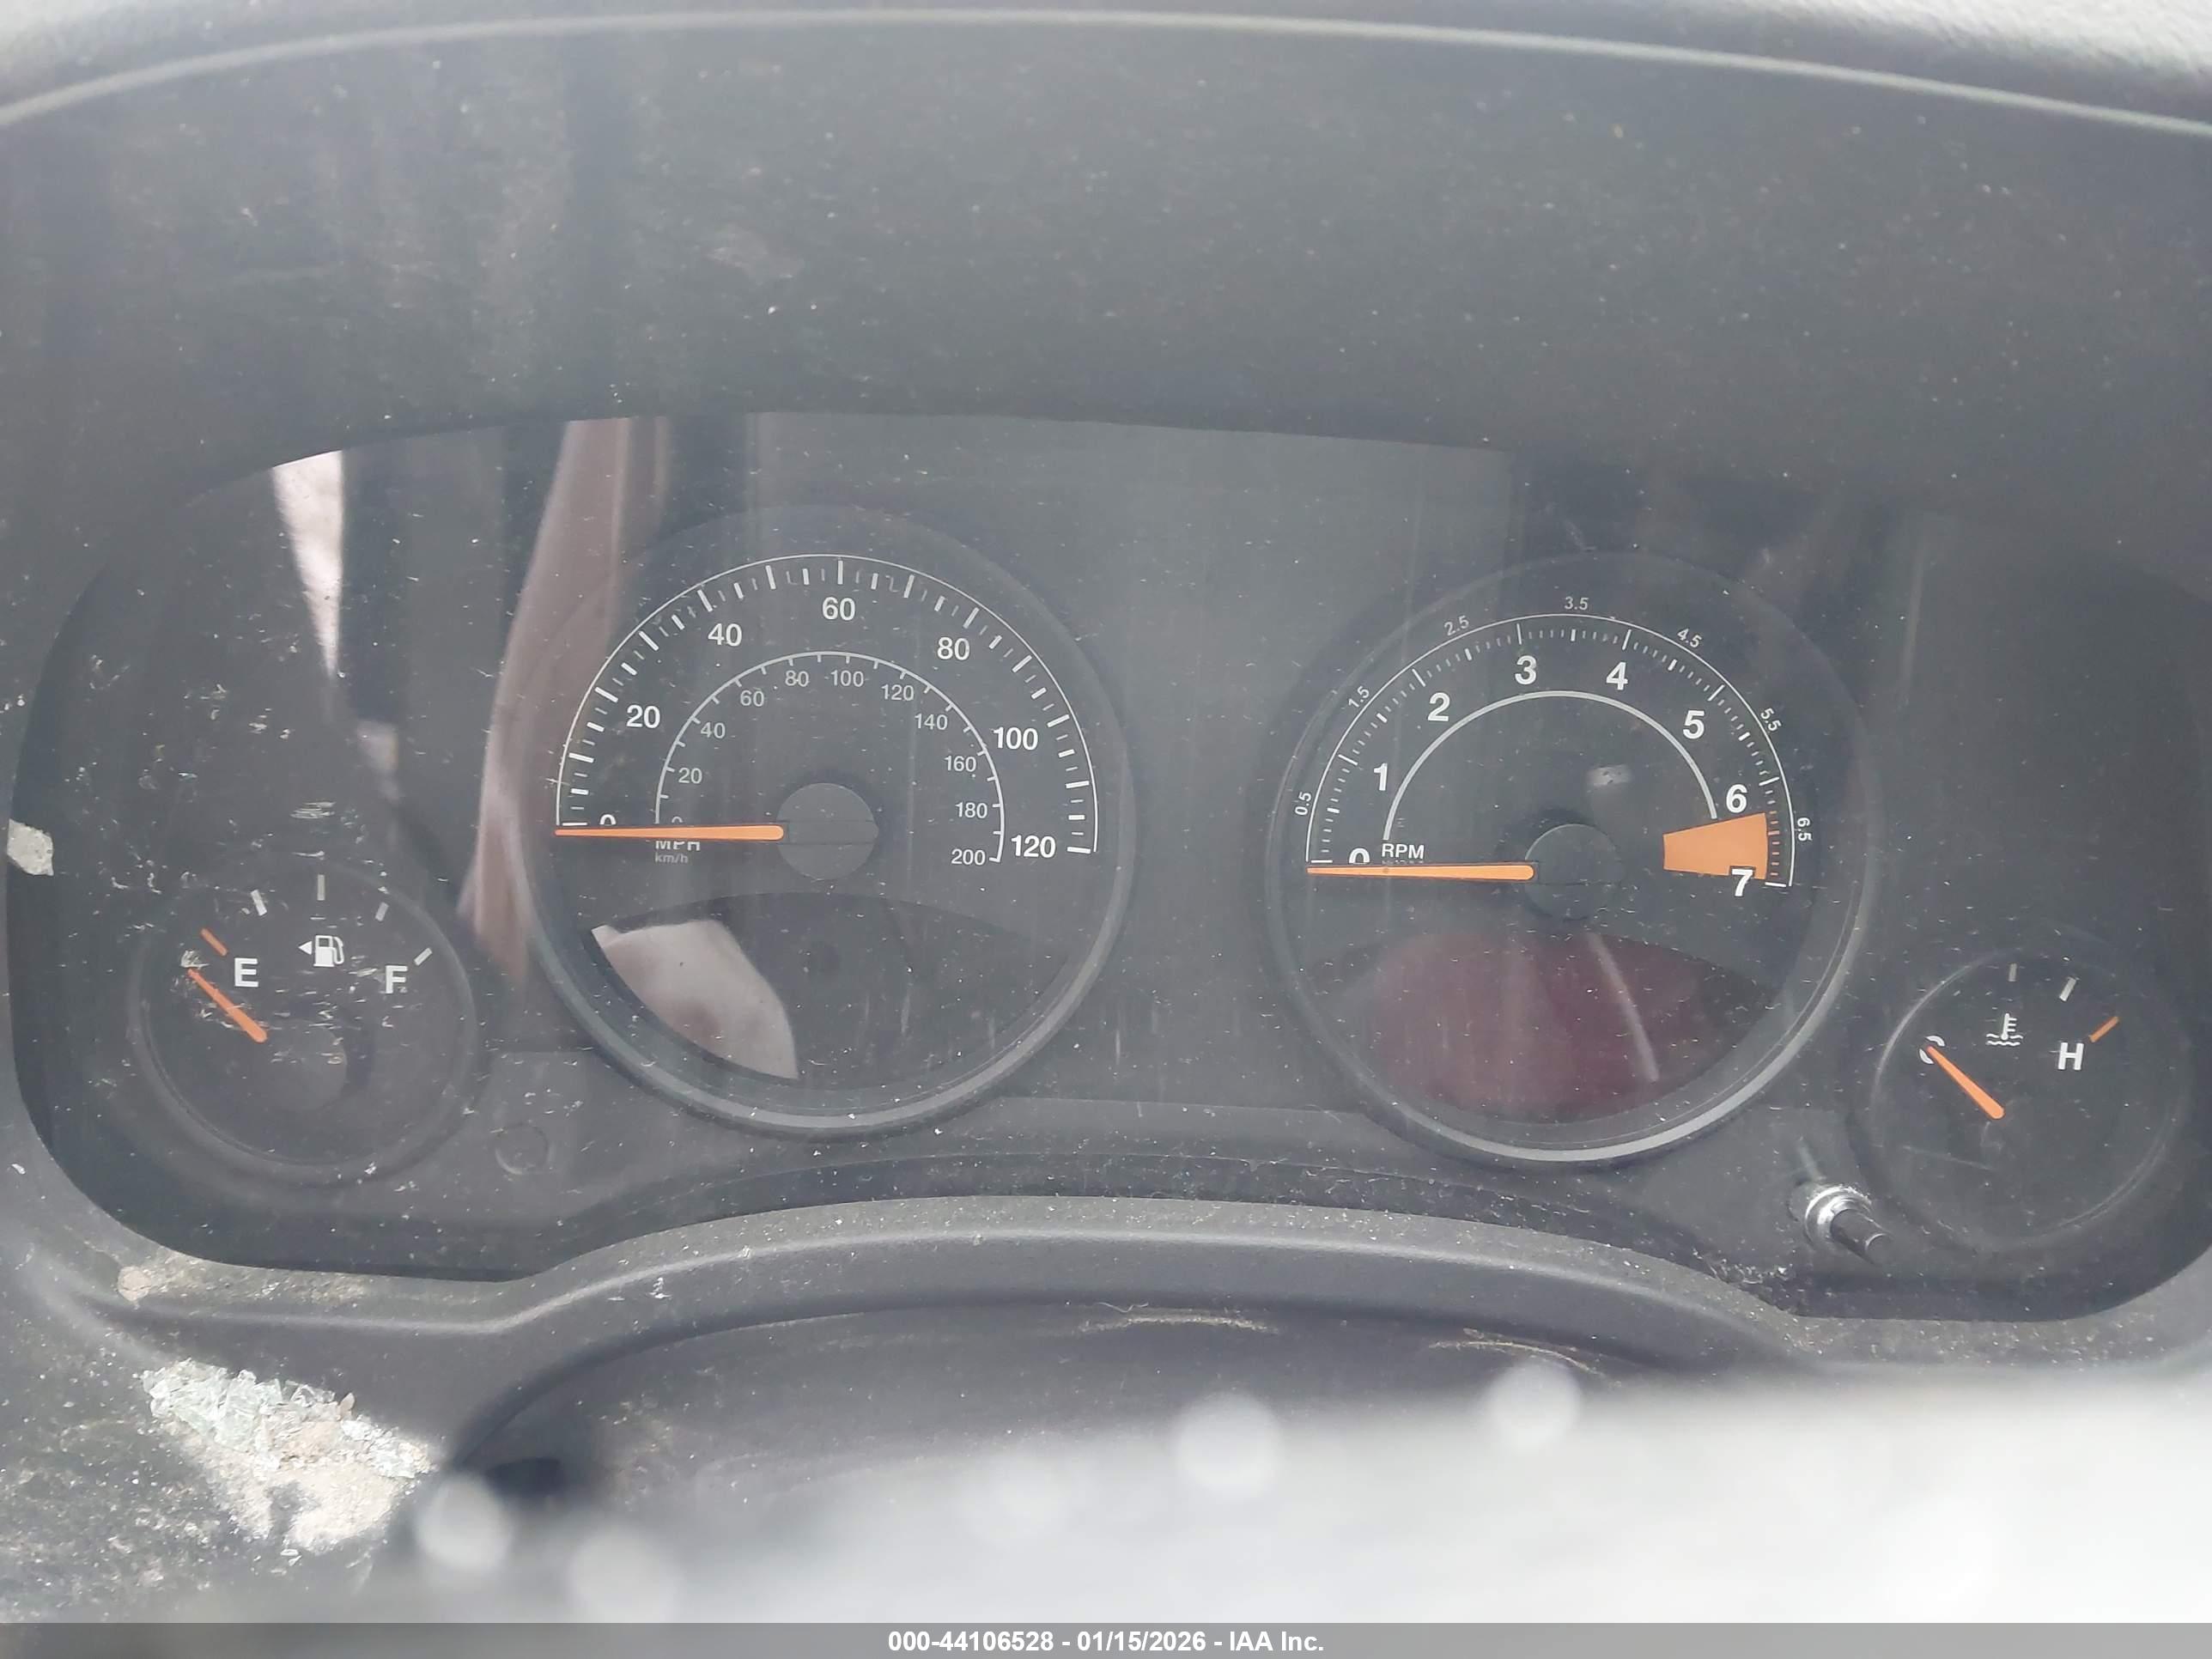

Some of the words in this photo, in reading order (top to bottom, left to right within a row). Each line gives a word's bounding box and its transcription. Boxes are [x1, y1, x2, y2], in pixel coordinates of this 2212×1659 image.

[823, 597, 854, 620] 60
[1565, 596, 1588, 611] 3.5
[708, 623, 742, 646] 40
[1444, 616, 1469, 636] 2.5
[938, 637, 969, 659] 80
[1677, 629, 1701, 647] 4.5
[786, 671, 809, 687] 80
[831, 671, 863, 687] 100
[1516, 656, 1536, 684] 3
[1607, 662, 1627, 690] 4
[741, 690, 764, 706] 60
[882, 684, 914, 701] 120
[1348, 686, 1370, 708] 1.5
[627, 705, 659, 728] 20
[1428, 693, 1449, 721] 2
[701, 722, 726, 738] 40
[915, 714, 947, 730] 140
[1683, 710, 1705, 738] 5
[1760, 708, 1781, 732] 5.5
[994, 727, 1037, 750] 100
[945, 756, 976, 771] 160
[679, 768, 702, 783] 20
[1374, 763, 1387, 791] 1
[1295, 792, 1311, 816] 0.5
[1727, 785, 1747, 812] 6
[956, 803, 987, 818] 180
[1797, 817, 1811, 841] 6.5
[951, 848, 985, 866] 200
[1012, 836, 1055, 857] 120
[1382, 843, 1424, 859] RPM
[1732, 868, 1753, 896] 7
[235, 958, 258, 987] E
[386, 965, 407, 994] F
[2058, 1042, 2083, 1070] H
